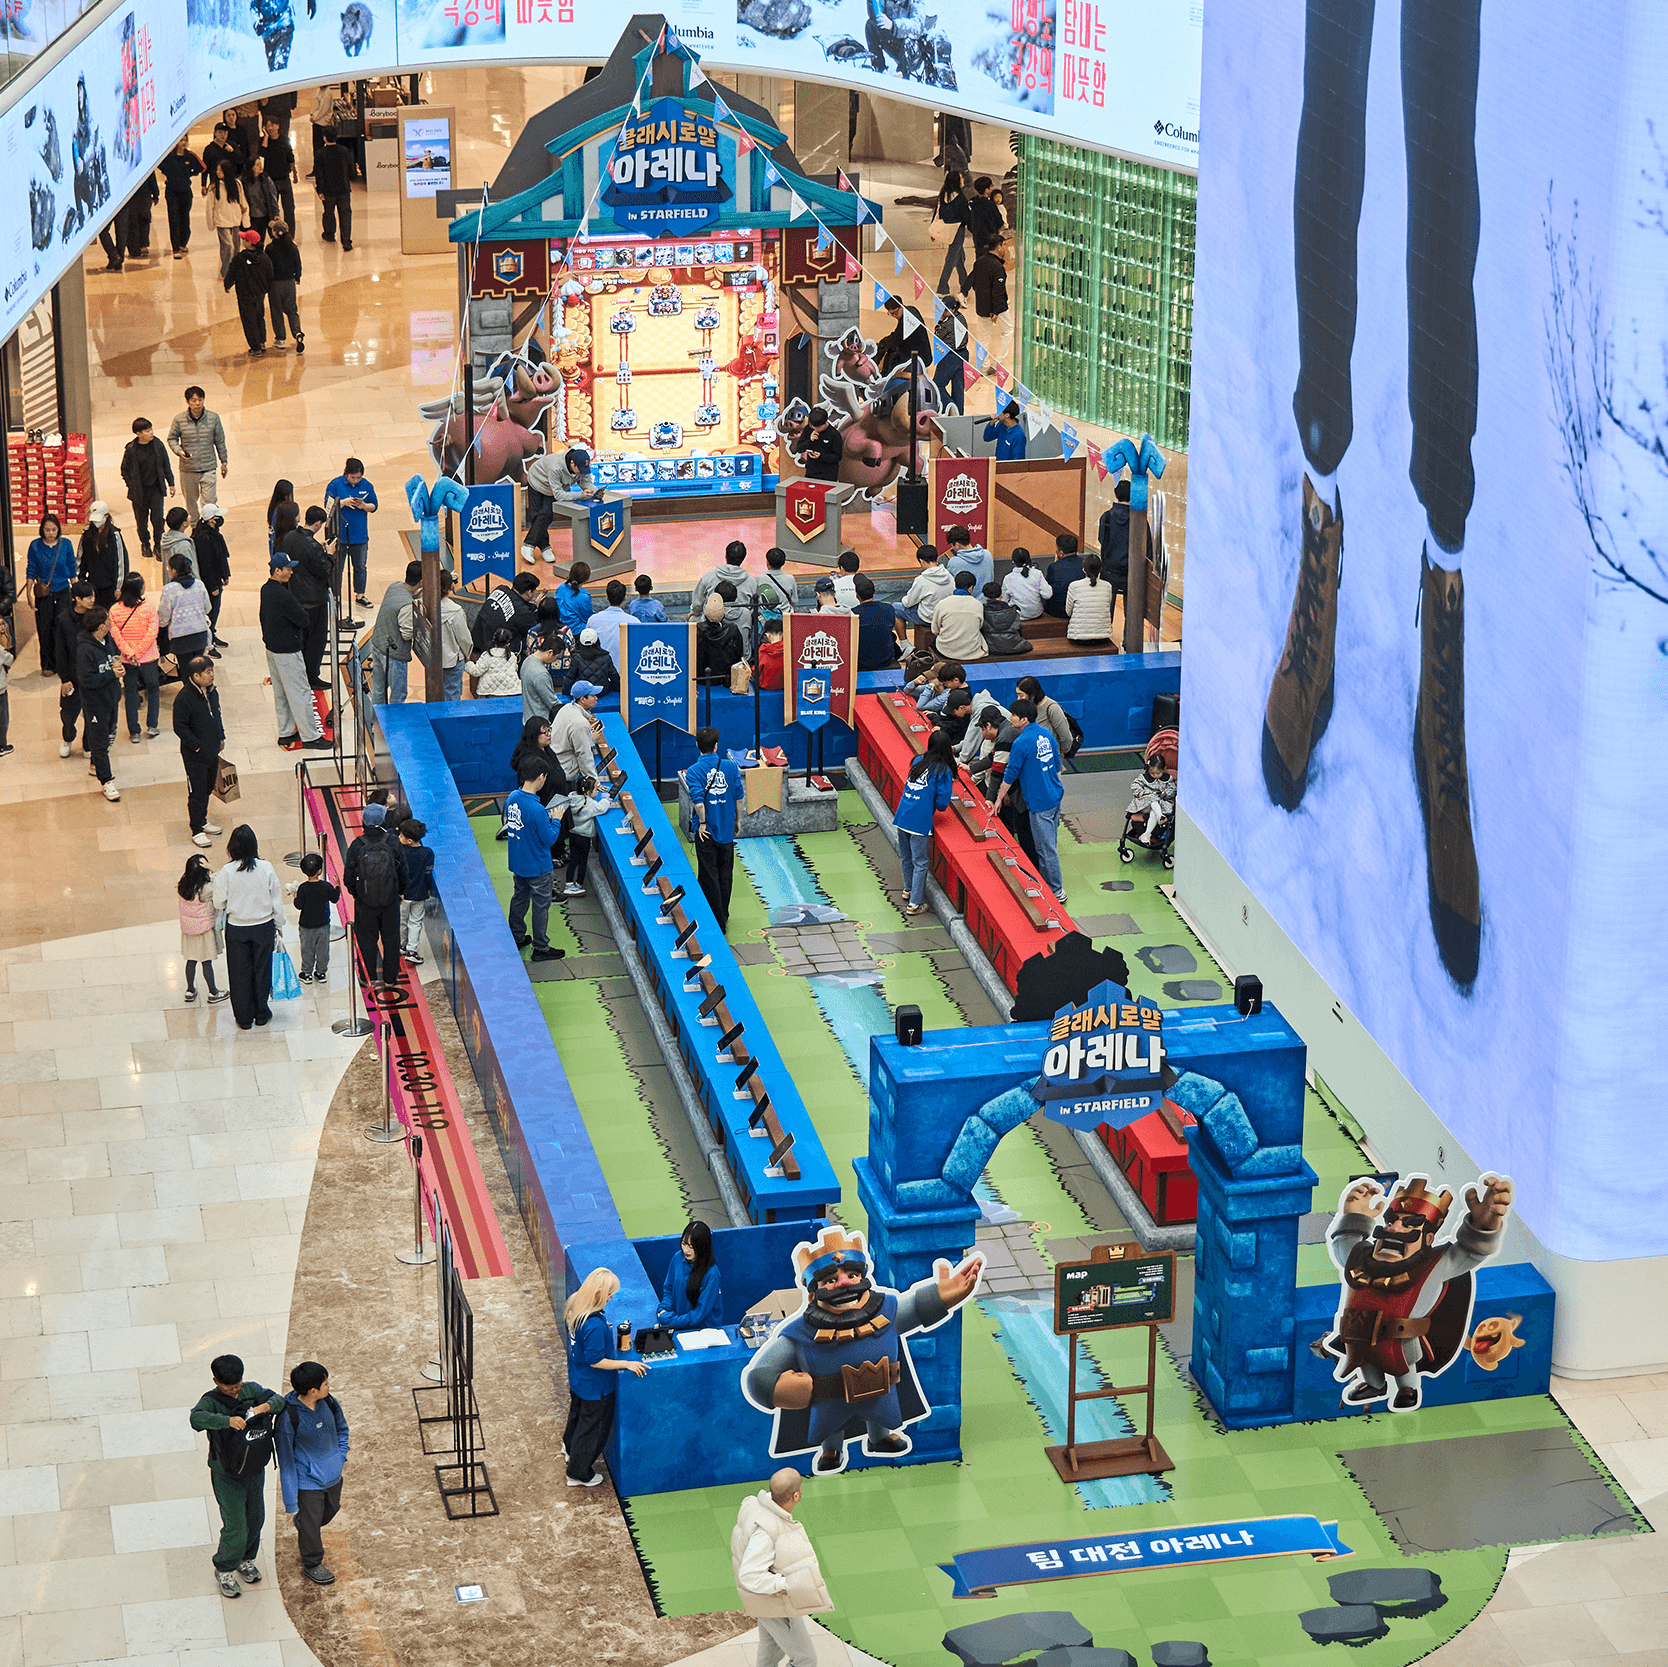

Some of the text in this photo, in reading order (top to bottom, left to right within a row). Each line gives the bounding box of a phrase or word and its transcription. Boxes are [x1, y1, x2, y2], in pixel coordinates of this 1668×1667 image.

[674, 24, 714, 39] lumbia
[1064, 0, 1106, 52] 탐내는
[1010, 40, 1106, 107] 극강의 따뜻함
[613, 147, 721, 188] 아레나
[640, 208, 708, 220] STARFIELD
[946, 487, 978, 500] 아레나
[471, 513, 504, 527] 아레나
[804, 646, 839, 659] 아레나
[640, 655, 676, 669] 아레나
[1043, 1032, 1167, 1080] 아레나
[1073, 1096, 1151, 1114] STARFIELD
[1026, 1530, 1255, 1570] 팀 대전 아레나
